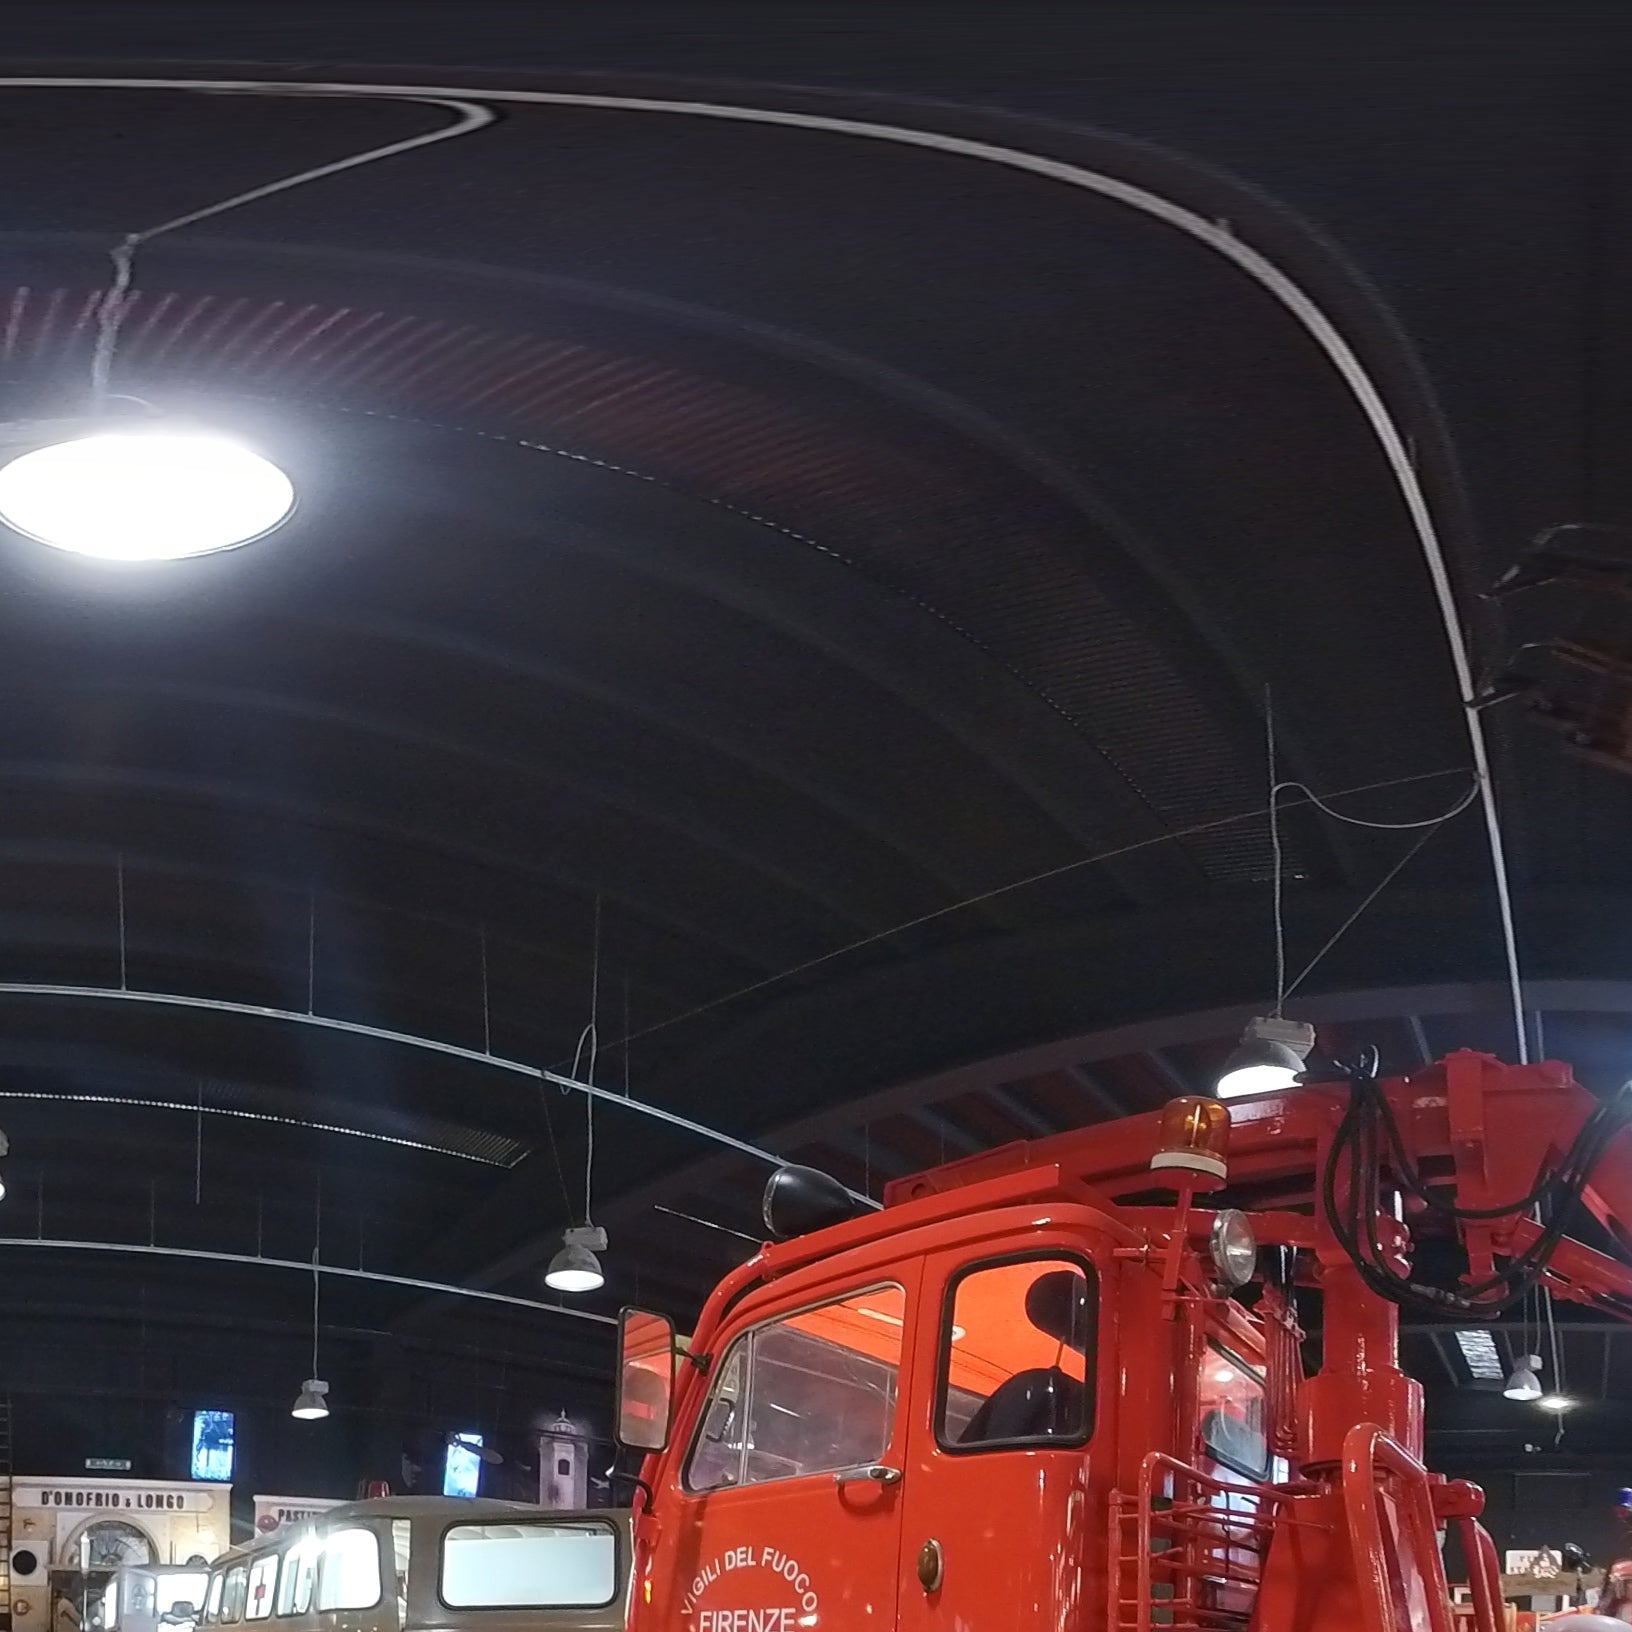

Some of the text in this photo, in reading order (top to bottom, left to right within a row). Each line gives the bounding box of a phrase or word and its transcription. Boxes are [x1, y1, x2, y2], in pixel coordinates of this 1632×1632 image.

[137, 1494, 185, 1509] LONGO
[278, 1508, 318, 1522] PASTI
[681, 1546, 817, 1614] VIGILI DEL FUOCO
